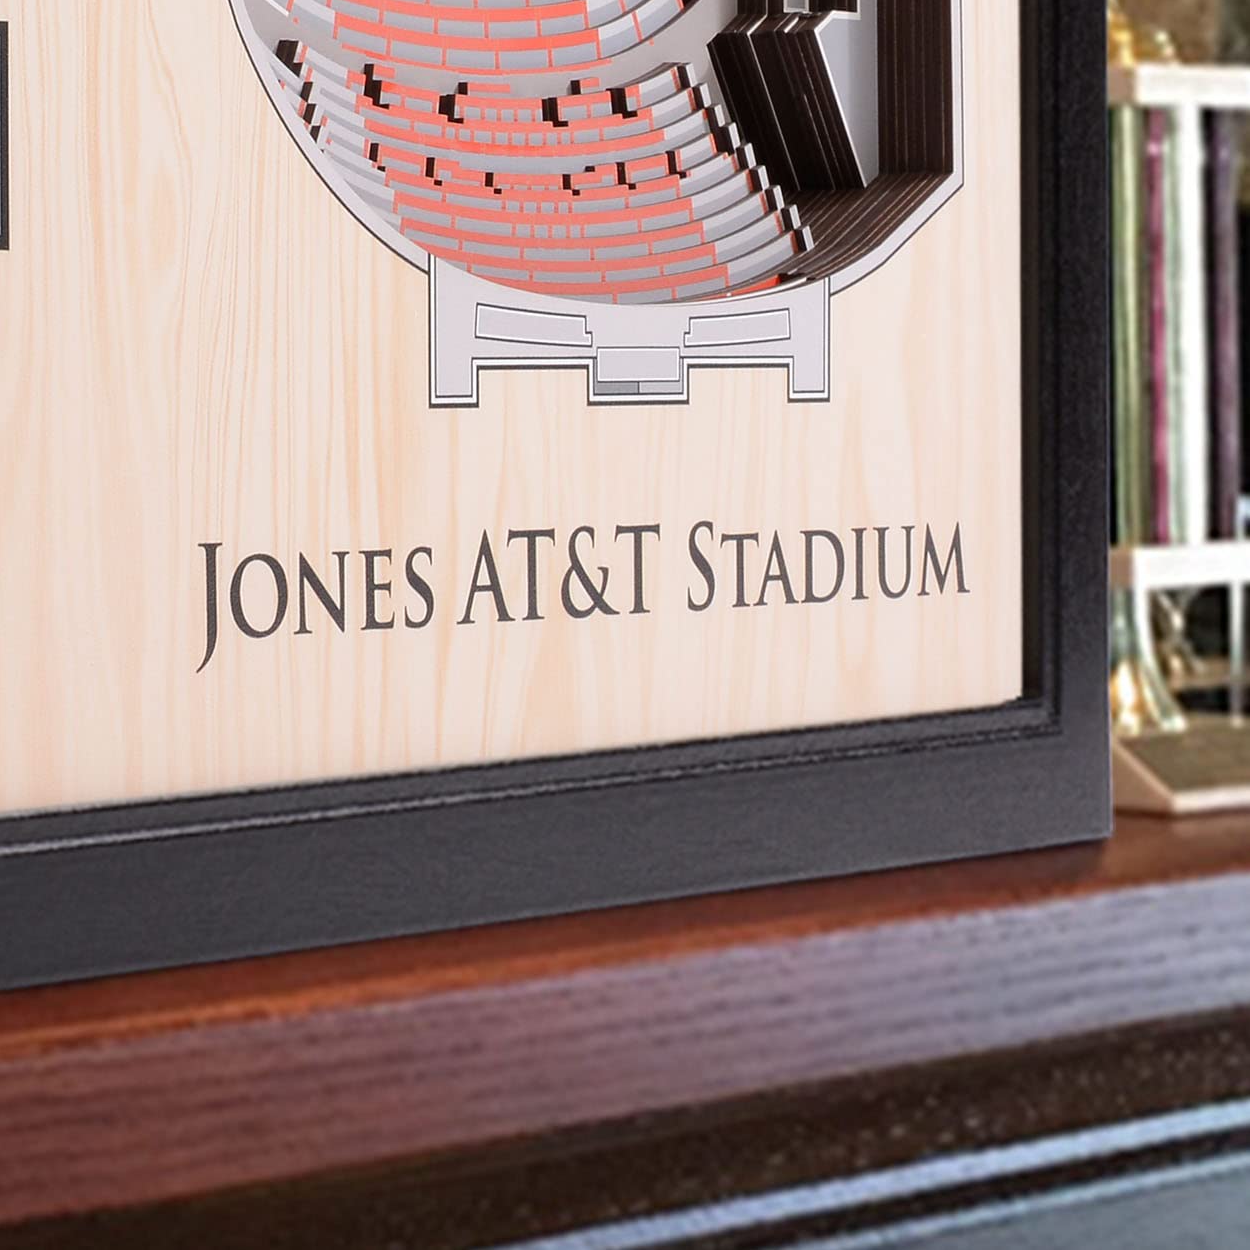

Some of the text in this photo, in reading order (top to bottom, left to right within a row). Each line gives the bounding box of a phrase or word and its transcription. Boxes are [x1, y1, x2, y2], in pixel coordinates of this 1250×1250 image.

[196, 520, 971, 674] JONES AT&T STADIUM
